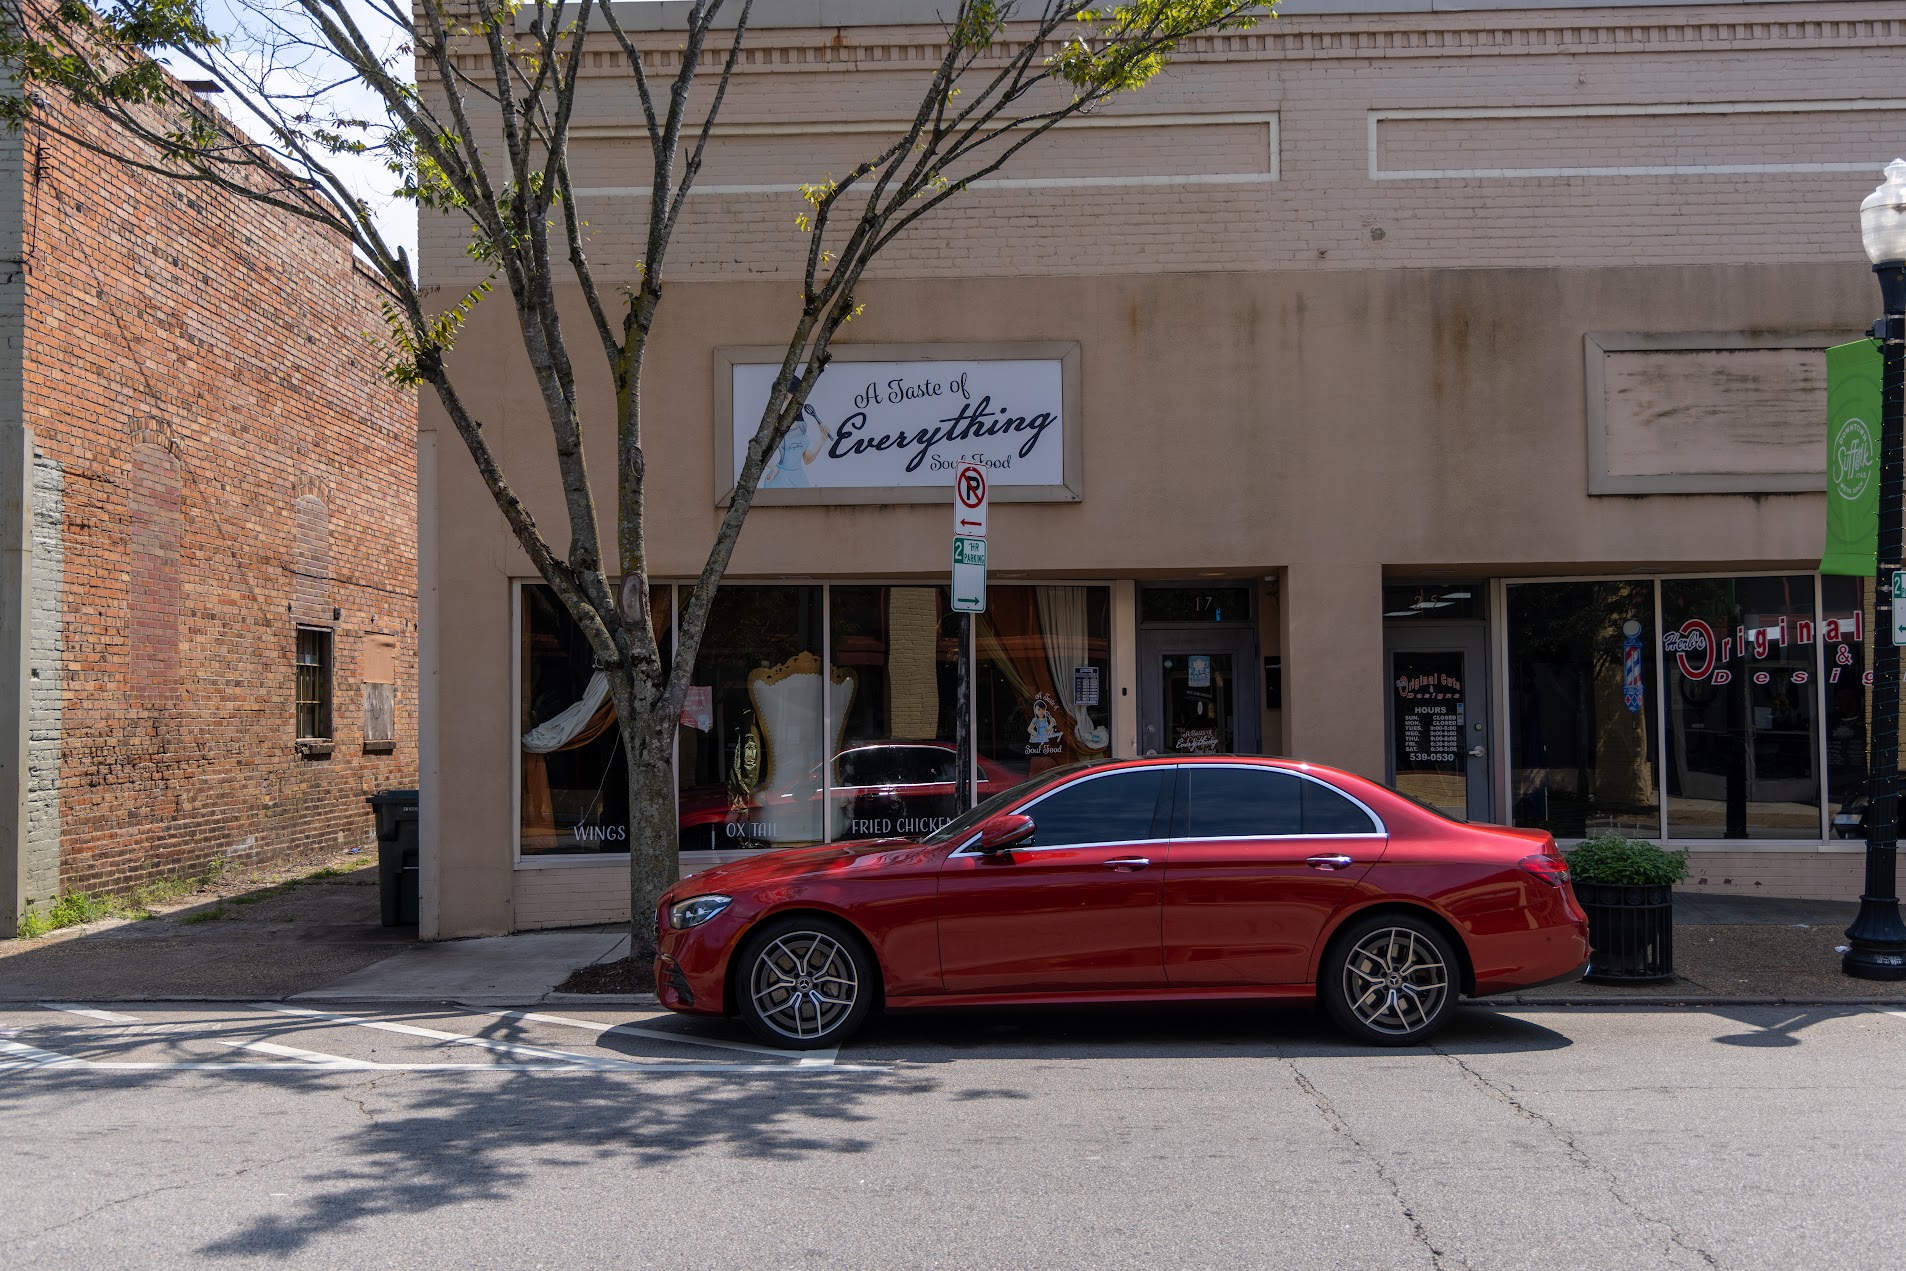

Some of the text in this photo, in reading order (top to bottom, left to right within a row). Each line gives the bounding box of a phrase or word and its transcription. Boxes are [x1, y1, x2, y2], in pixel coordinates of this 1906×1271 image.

[854, 372, 971, 409] A Taste of
[828, 395, 1058, 473] Everything
[1838, 423, 1868, 444] DOWNTOWN
[1833, 438, 1873, 483] Suffolk
[954, 541, 962, 560] 2
[964, 553, 985, 564] PARKING
[1894, 577, 1901, 594] 2
[1193, 596, 1213, 612] 17
[1663, 631, 1706, 651] Herb's
[1676, 610, 1863, 681] Original
[1835, 643, 1853, 666] &
[1398, 673, 1438, 697] Original
[1414, 706, 1447, 714] HOURS
[1024, 744, 1062, 755] Soul Food
[1409, 753, 1455, 761] 539-0530
[574, 825, 626, 841] WINGS
[726, 822, 779, 838] OX TAIL
[852, 819, 891, 835] FRIED
